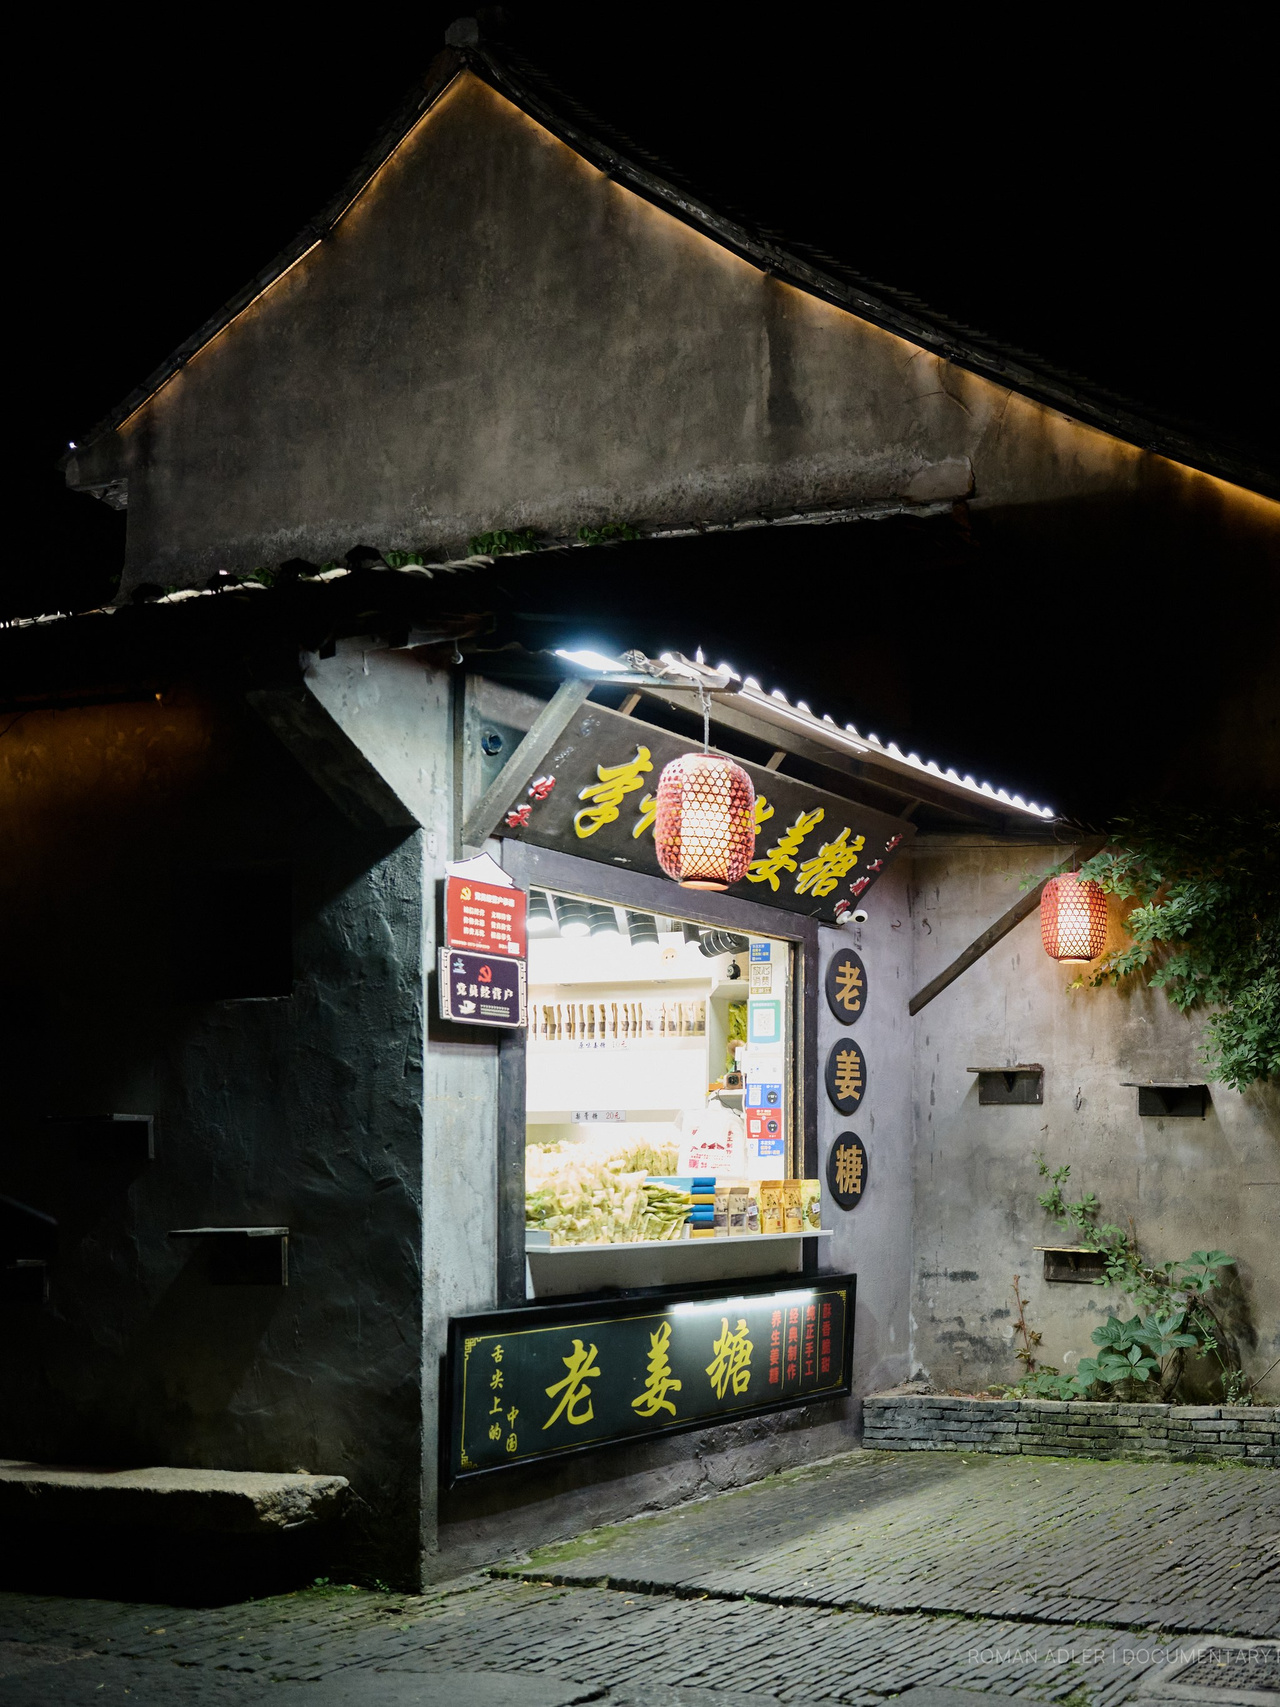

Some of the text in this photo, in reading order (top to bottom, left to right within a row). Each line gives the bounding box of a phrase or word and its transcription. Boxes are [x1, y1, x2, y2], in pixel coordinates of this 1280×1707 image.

[573, 745, 866, 898] 李姜糖
[456, 982, 514, 1001] 党员经营户
[835, 960, 863, 1194] 老姜糖
[541, 1317, 754, 1430] 老姜糖
[787, 1307, 799, 1380] 经典制作
[804, 1304, 817, 1376] 纯正手工
[489, 1344, 505, 1441] 舌尖上的
[505, 1405, 520, 1453] 中国
